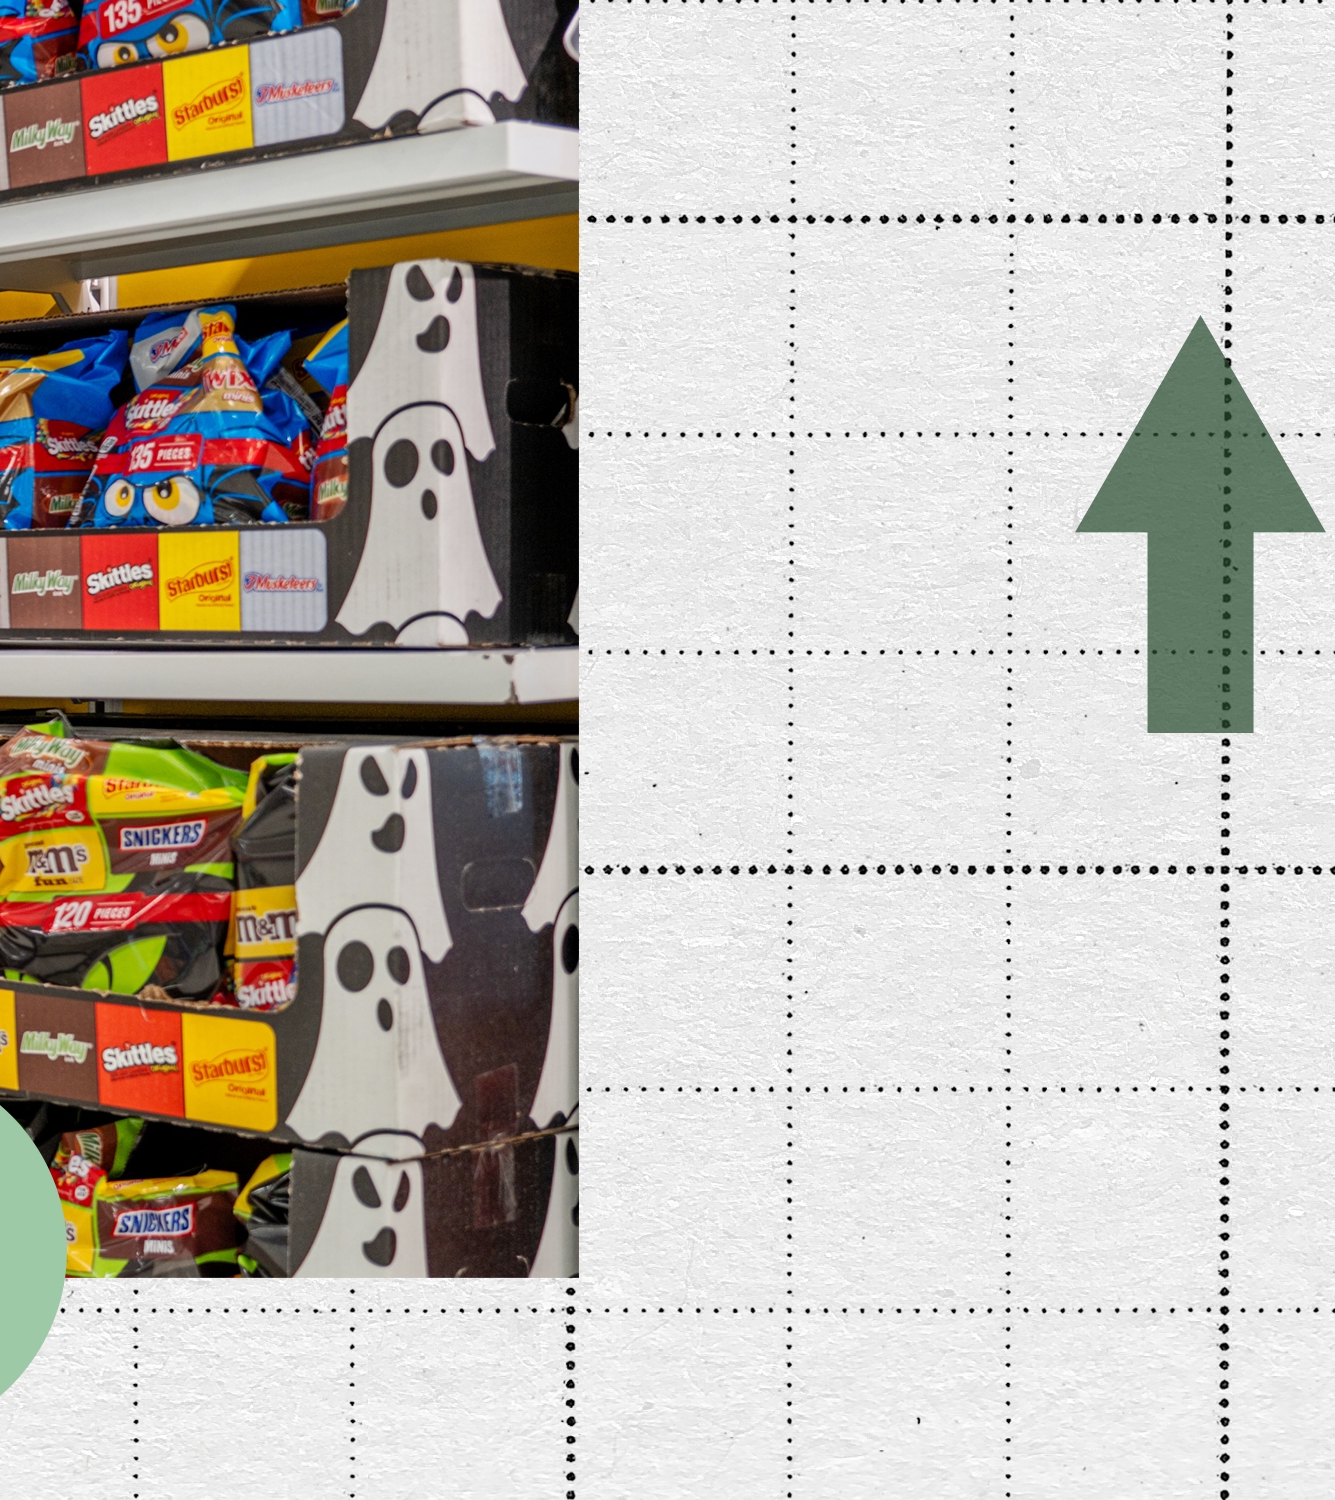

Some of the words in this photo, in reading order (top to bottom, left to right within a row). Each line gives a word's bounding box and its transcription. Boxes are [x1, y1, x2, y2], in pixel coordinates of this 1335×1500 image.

[88, 95, 159, 140] Skittles
[172, 76, 245, 129] Starburst
[207, 111, 244, 125] Original
[222, 391, 255, 403] minis
[129, 442, 156, 472] 135
[157, 447, 192, 460] PIECES
[86, 563, 154, 595] Skittles
[167, 560, 233, 602] Starburst
[197, 592, 232, 604] Original
[0, 784, 74, 821] Skittles
[124, 823, 203, 847] SNICKERS
[52, 900, 93, 928] 120
[93, 906, 132, 919] PIECES
[103, 1042, 178, 1075] Skittles
[190, 1049, 267, 1084] Starburst
[227, 1082, 266, 1098] Original
[118, 1204, 191, 1234] SNICKERS
